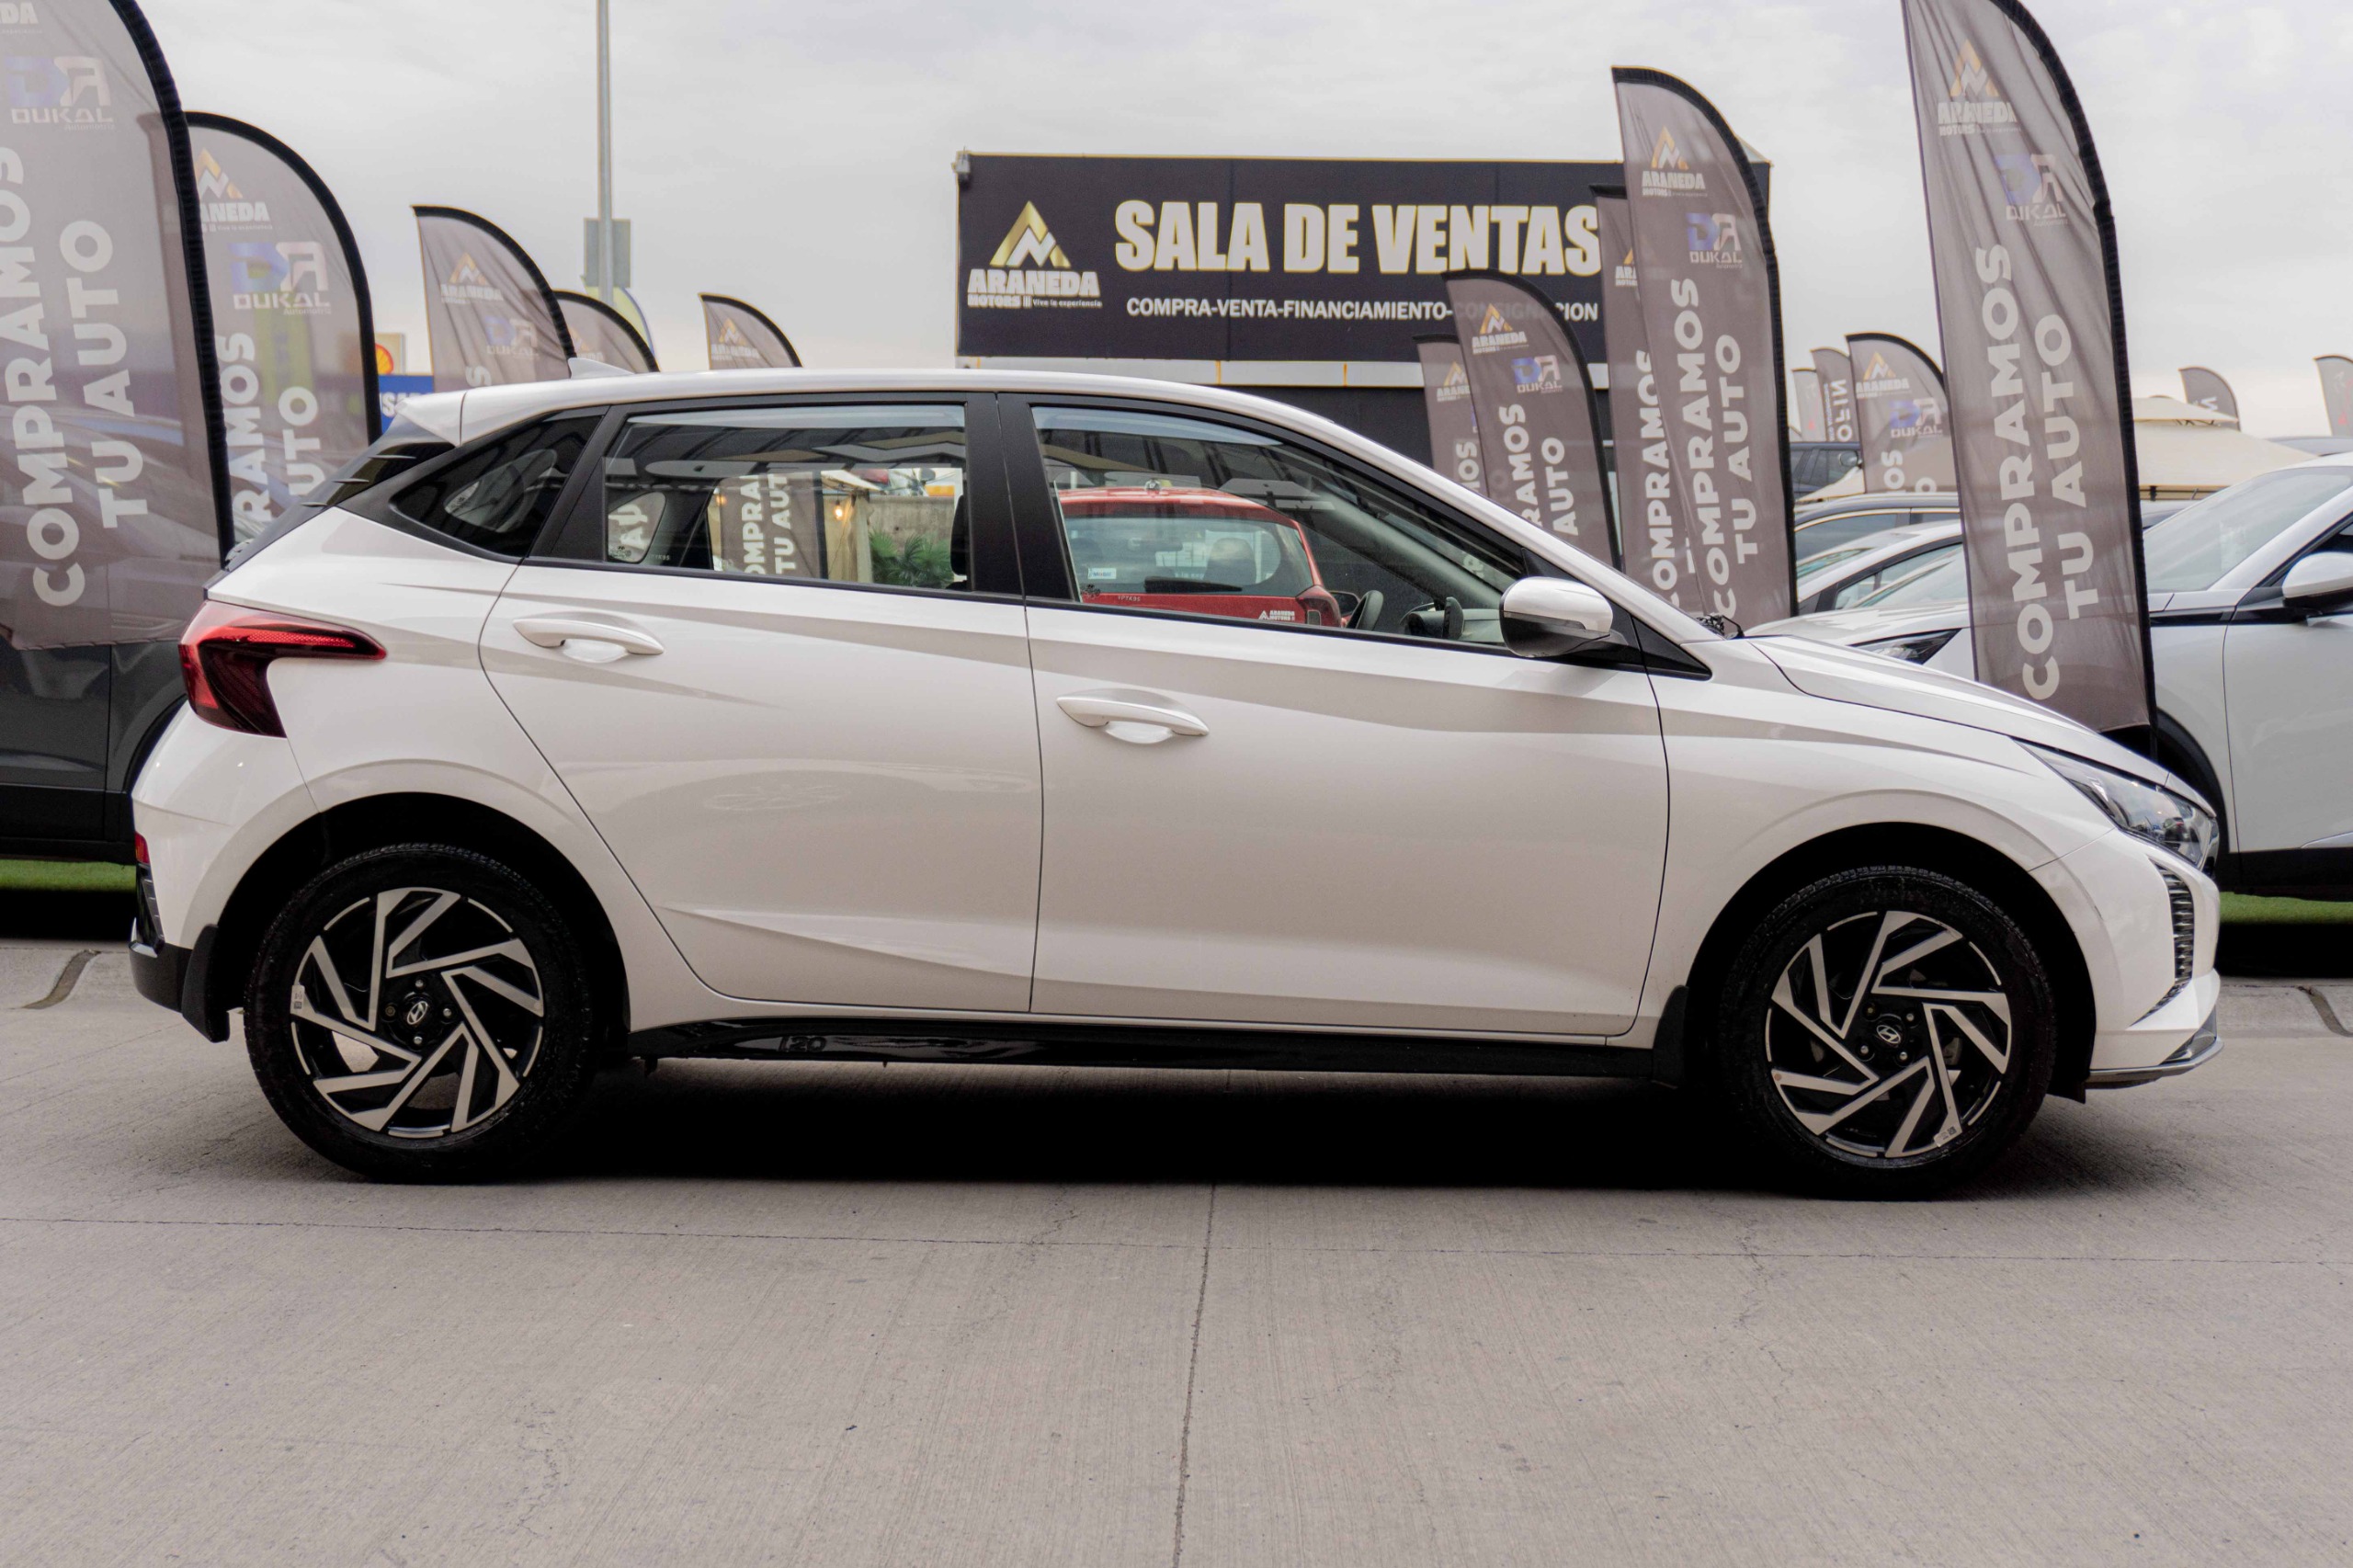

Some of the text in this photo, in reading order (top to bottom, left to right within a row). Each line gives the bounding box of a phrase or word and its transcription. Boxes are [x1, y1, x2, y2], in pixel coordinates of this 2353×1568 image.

[0, 2, 39, 25] DA
[10, 108, 114, 124] DUKAL
[1641, 171, 1706, 189] ARANEDA
[1114, 199, 1602, 277] SALA DE VENTAS
[1689, 251, 1743, 264] DUKAL
[233, 292, 332, 310] DUKAL
[967, 268, 1101, 298] ARANEDA
[967, 293, 1021, 309] MOTORS
[60, 221, 148, 528] TU AUTO
[1636, 349, 1680, 608] OMPRAMOS
[1671, 278, 1736, 627] COMPRAMOS
[1715, 335, 1757, 564] TU AUTO
[1881, 449, 1907, 494] OS
[1975, 244, 2060, 700] COMPRAMOS
[2034, 313, 2099, 619] TU AUTO
[1541, 437, 1579, 536] AUTO
[739, 474, 766, 574] MPRA
[774, 537, 796, 574] TU
